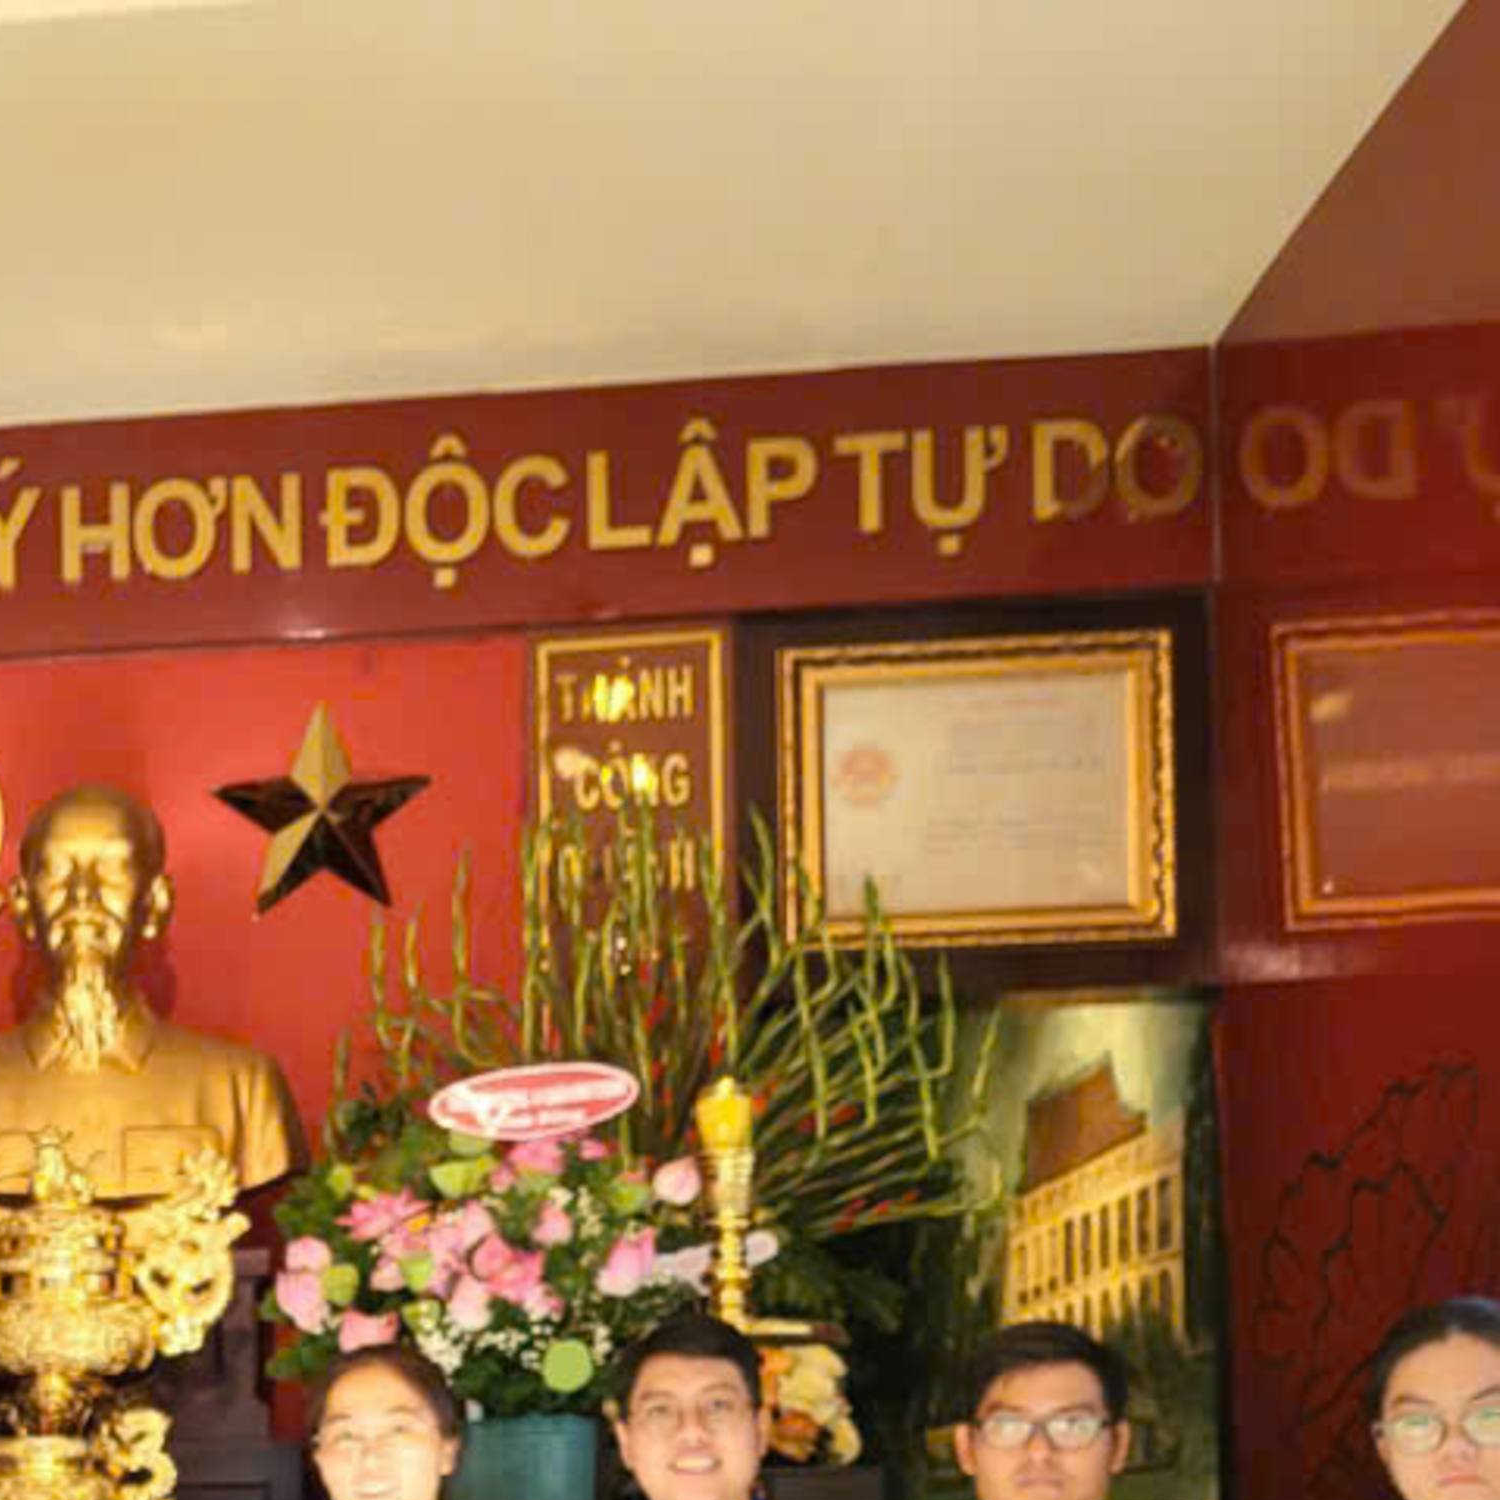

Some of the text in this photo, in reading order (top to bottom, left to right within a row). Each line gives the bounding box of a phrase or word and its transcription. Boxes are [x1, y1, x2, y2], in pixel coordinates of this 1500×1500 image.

[60, 472, 301, 584] HƠN
[319, 432, 571, 589] ĐỘC
[585, 417, 819, 567] LẬP
[833, 421, 1010, 556] TỰ
[1031, 412, 1204, 526] DO
